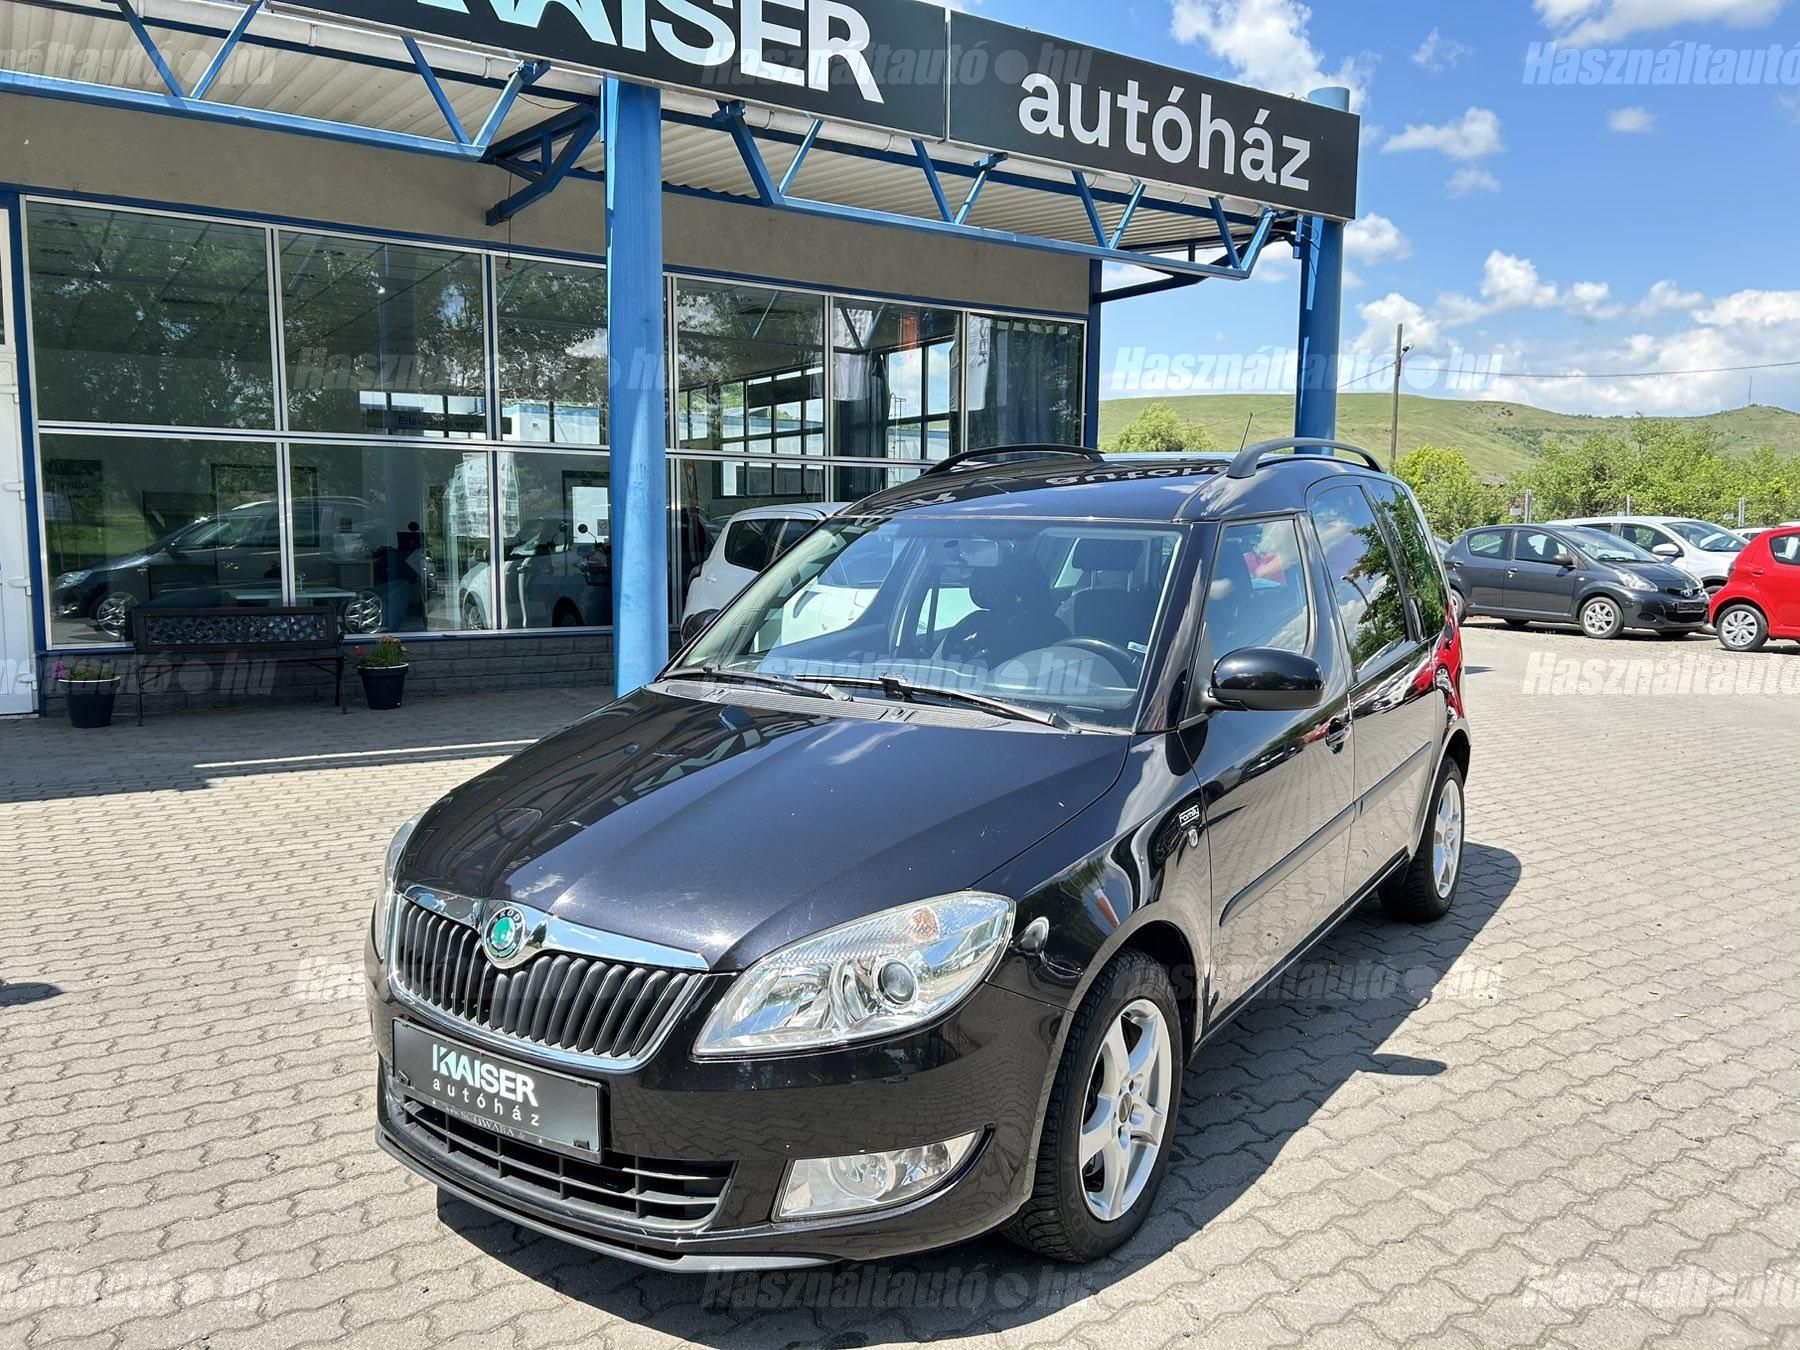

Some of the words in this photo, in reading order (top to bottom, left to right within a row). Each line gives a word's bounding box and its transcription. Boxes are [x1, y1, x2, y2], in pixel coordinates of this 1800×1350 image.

[417, 0, 884, 104] SER
[1018, 72, 1311, 191] autóház
[432, 1043, 539, 1107] KAISER
[433, 1076, 540, 1127] autóház
